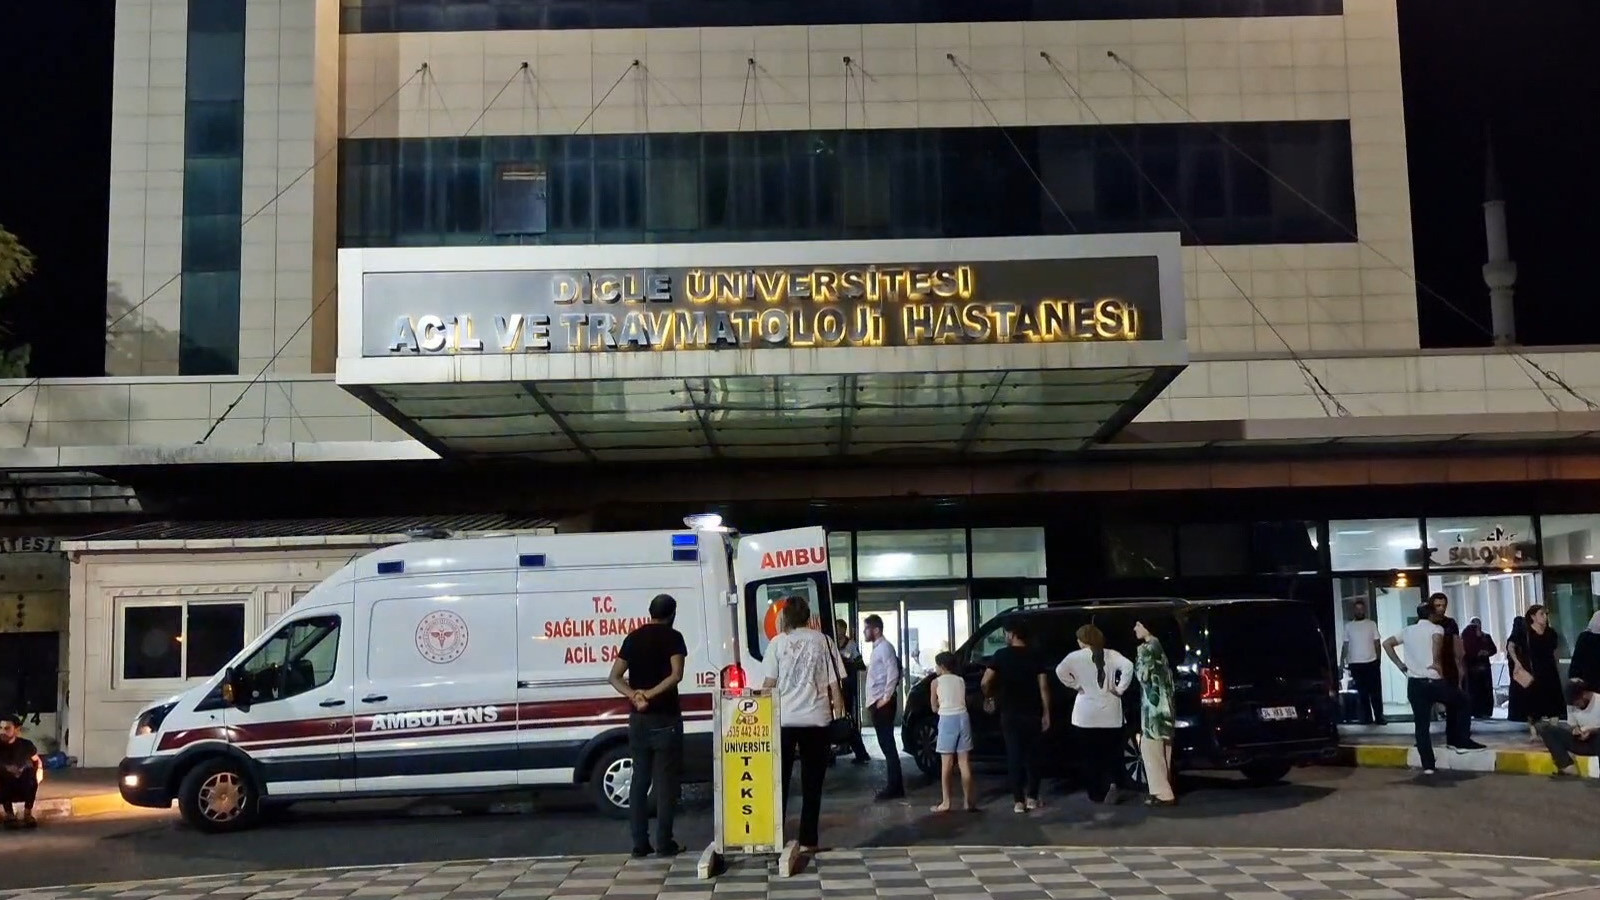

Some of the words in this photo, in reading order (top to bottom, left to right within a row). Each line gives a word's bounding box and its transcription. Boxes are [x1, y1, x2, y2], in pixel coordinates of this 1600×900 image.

[552, 270, 672, 304] DİCLE
[389, 313, 484, 352] ACİL
[495, 313, 551, 351] VE
[761, 546, 826, 569] AMBU
[592, 596, 617, 613] T.C.
[544, 617, 595, 638] SAĞLIK
[564, 643, 597, 664] ACİL
[696, 671, 716, 684] 112
[744, 702, 754, 711] P
[370, 705, 498, 731] AMBULANS
